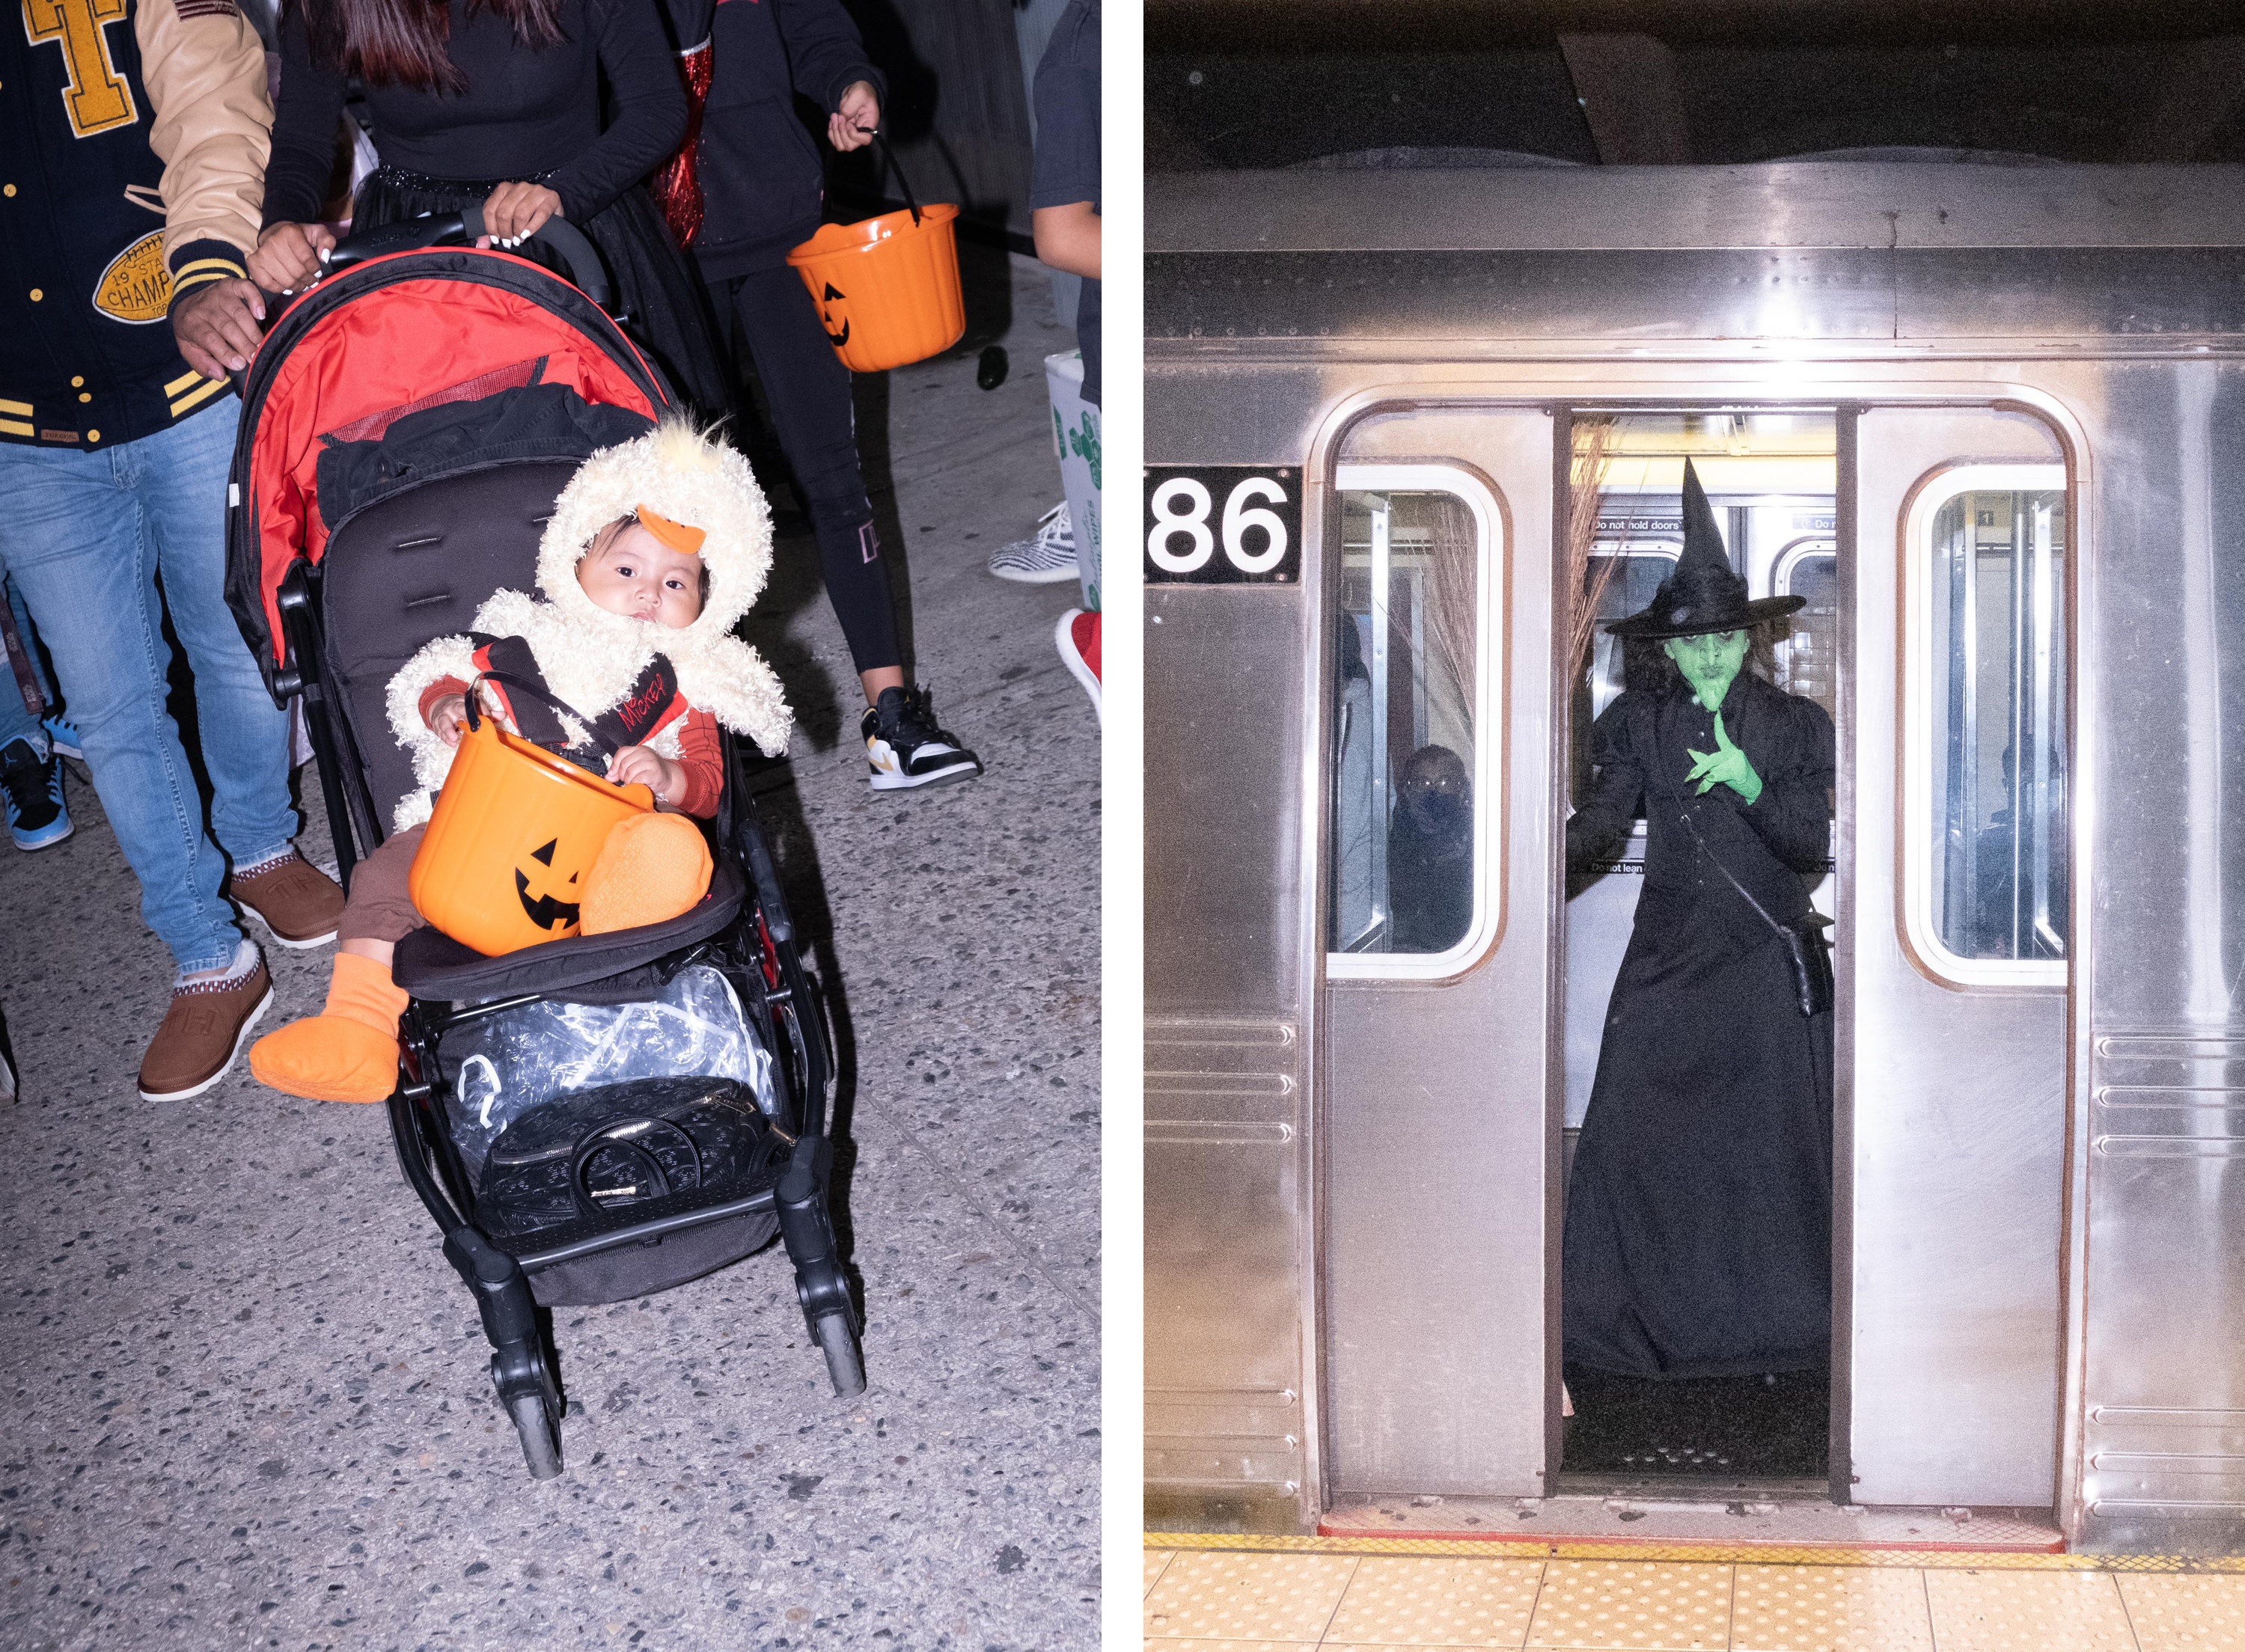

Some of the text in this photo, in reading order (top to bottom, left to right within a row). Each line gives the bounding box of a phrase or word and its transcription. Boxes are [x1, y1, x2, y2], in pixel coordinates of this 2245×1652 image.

[113, 272, 129, 287] 19
[152, 303, 167, 315] TOP
[1087, 500, 1099, 545] WIPES
[1147, 477, 1287, 573] 86
[1609, 521, 1625, 529] not
[1628, 521, 1648, 529] hold
[1651, 521, 1679, 530] doors
[1815, 519, 1829, 529] Do
[1623, 863, 1643, 872] lean
